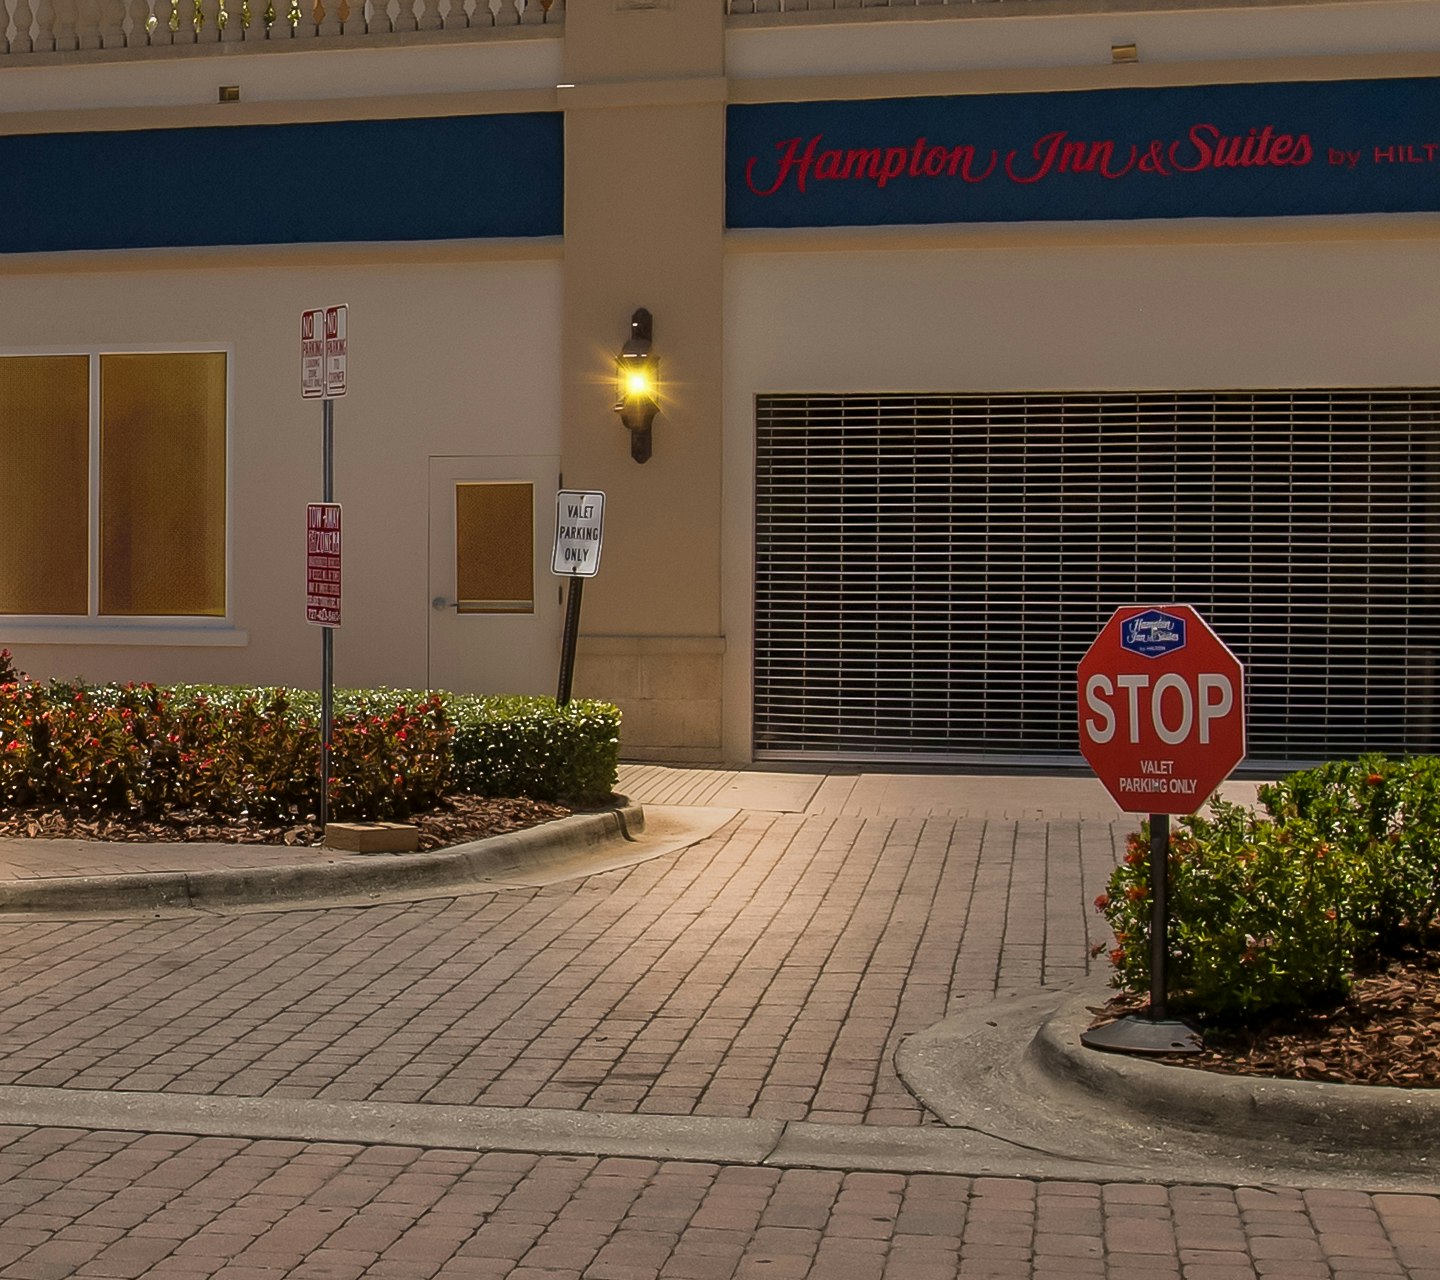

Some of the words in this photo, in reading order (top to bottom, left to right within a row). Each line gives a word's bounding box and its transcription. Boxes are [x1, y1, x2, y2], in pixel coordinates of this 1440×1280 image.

[745, 133, 998, 196] Hampton
[1005, 131, 1138, 184] Inn
[1138, 140, 1172, 176] &
[1168, 123, 1314, 172] Suites
[1328, 147, 1361, 169] by
[303, 315, 313, 338] NO
[327, 311, 337, 335] NO
[302, 341, 323, 356] PARKING
[326, 340, 346, 355] PARKING
[567, 505, 594, 519] VALET
[560, 526, 599, 540] PARKING
[564, 548, 589, 562] ONLY
[1085, 673, 1233, 745] STOP
[1140, 760, 1174, 774] VALET
[1120, 778, 1168, 793] PARKING
[1169, 779, 1197, 794] ONLY
